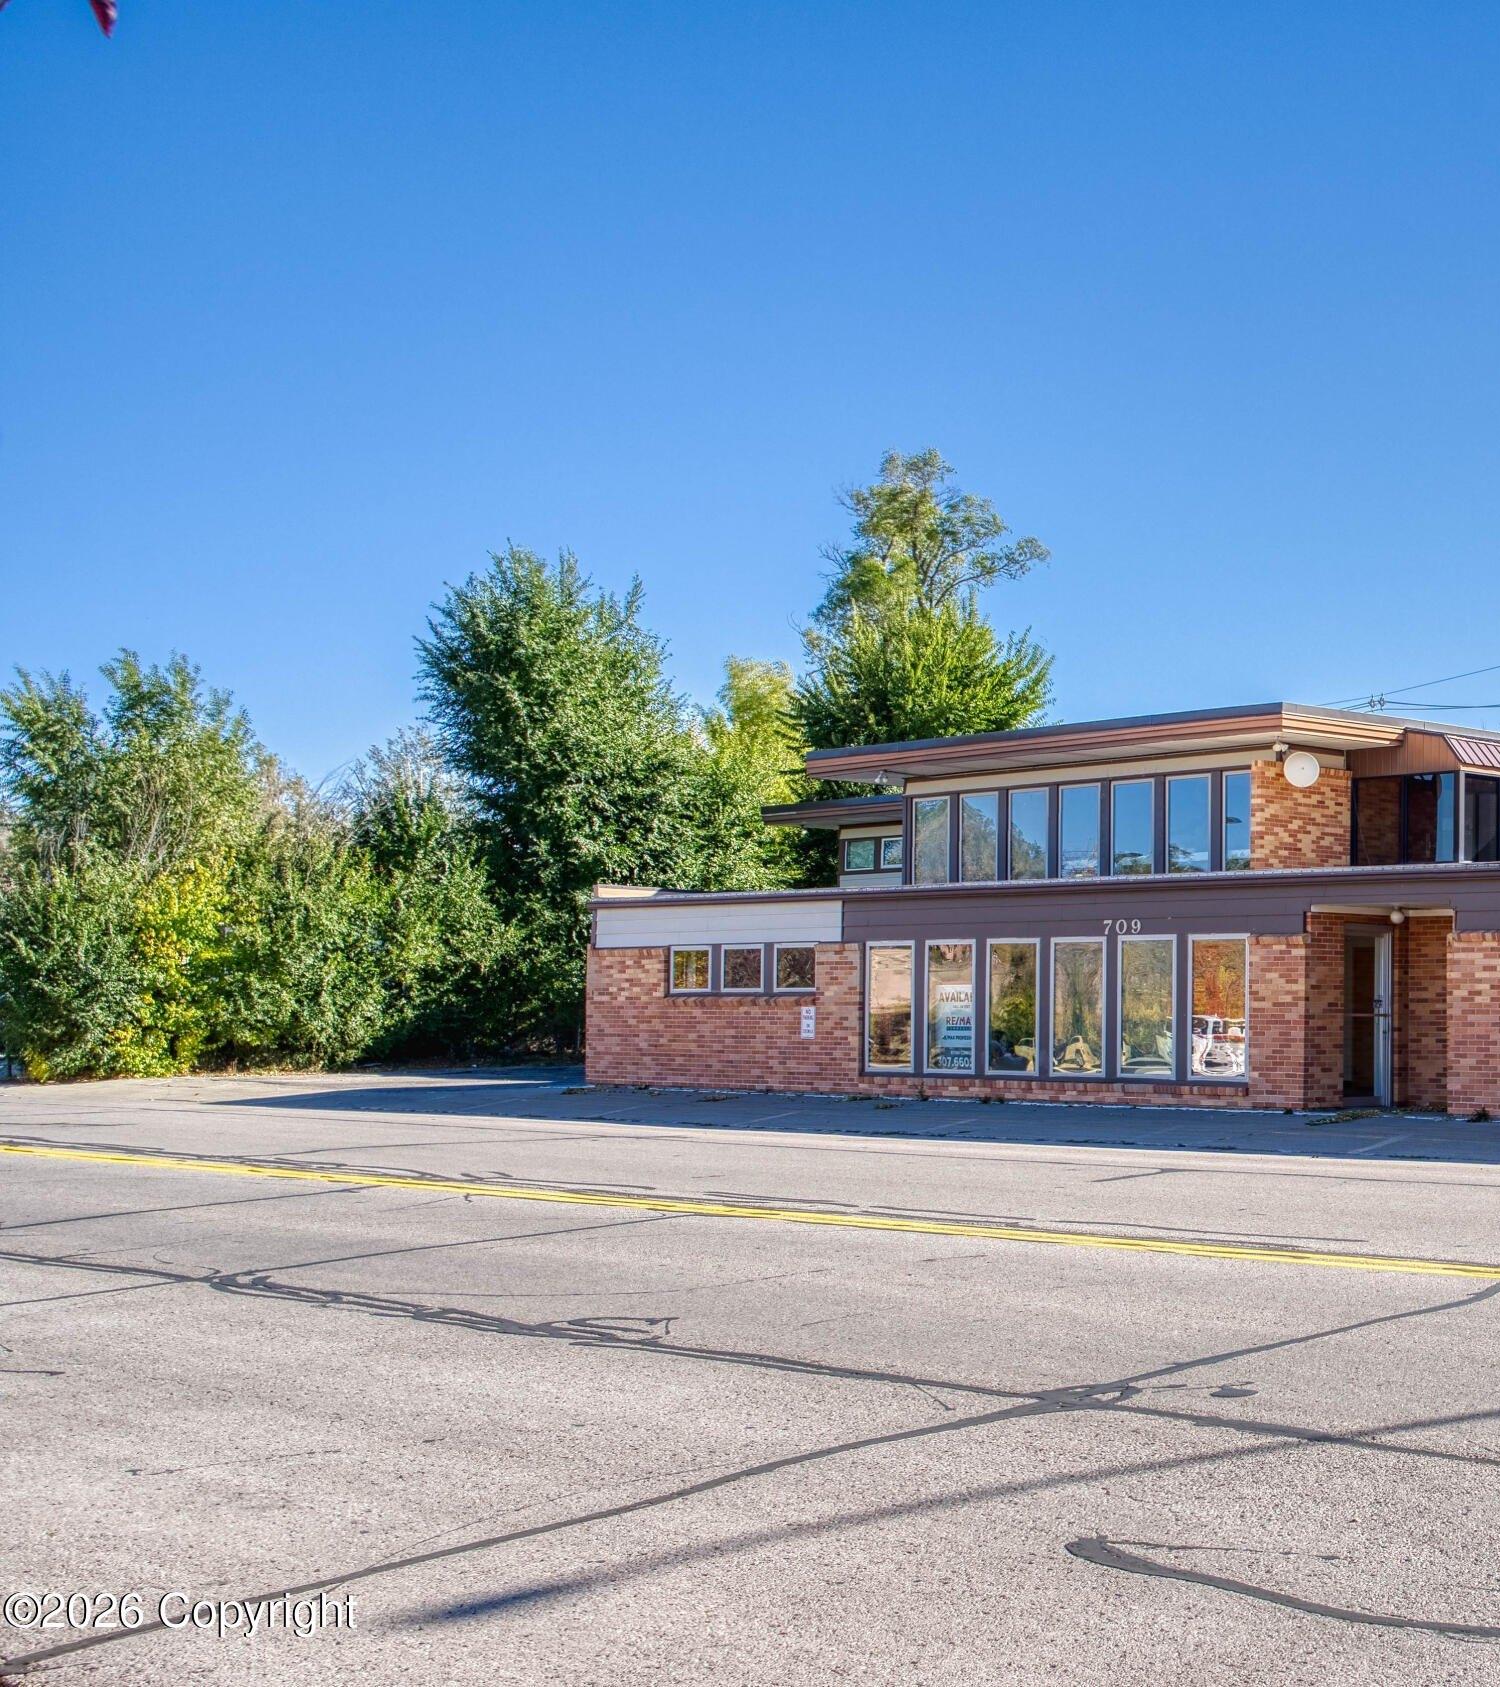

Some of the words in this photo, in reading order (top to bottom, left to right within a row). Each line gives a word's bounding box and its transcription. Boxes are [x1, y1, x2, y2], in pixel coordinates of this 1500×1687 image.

[1103, 919, 1141, 935] 709
[939, 991, 972, 1002] AVAILA
[946, 1016, 972, 1025] RE/MA
